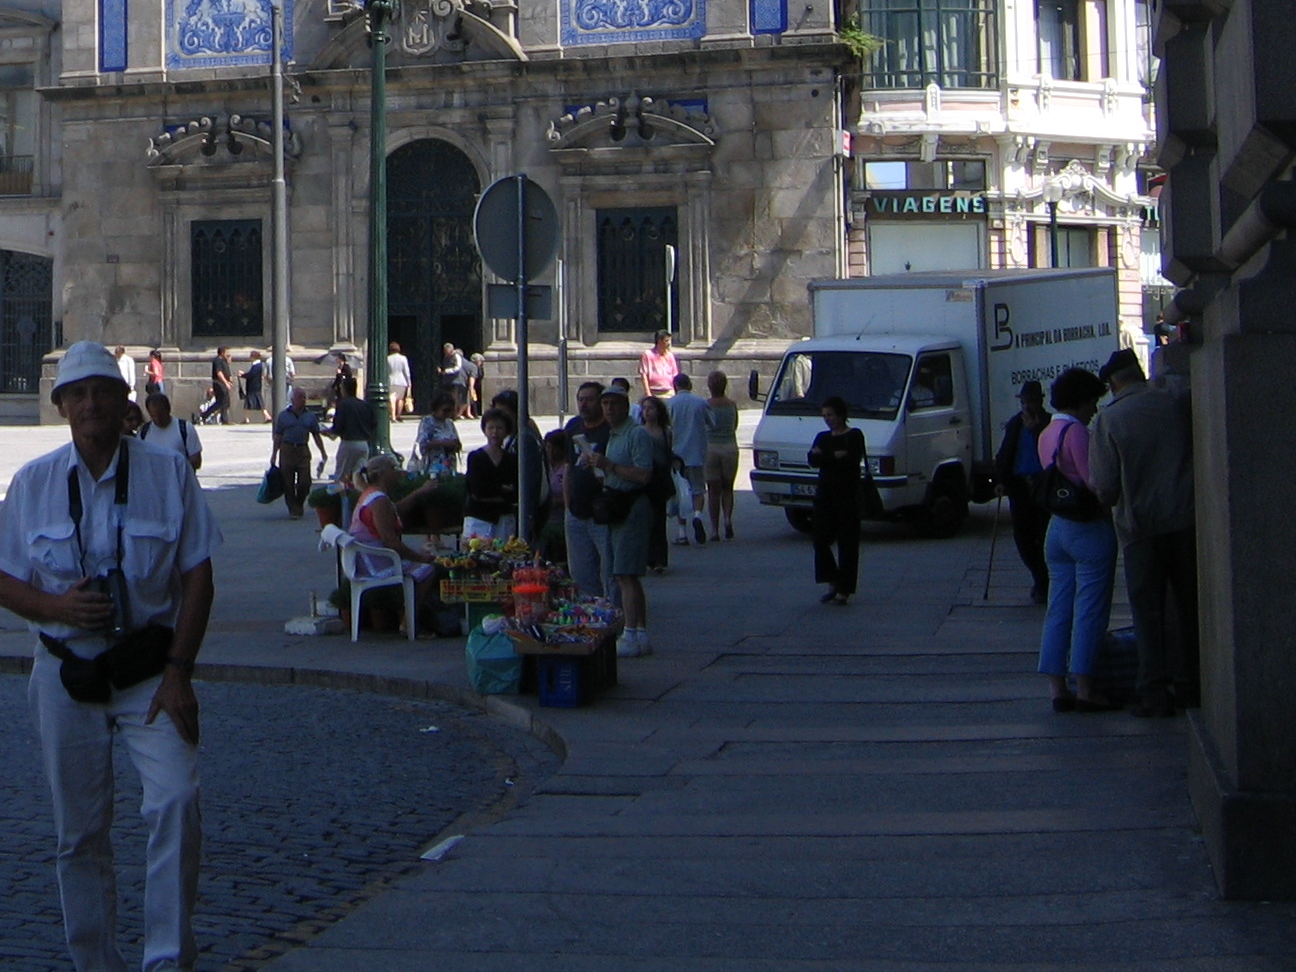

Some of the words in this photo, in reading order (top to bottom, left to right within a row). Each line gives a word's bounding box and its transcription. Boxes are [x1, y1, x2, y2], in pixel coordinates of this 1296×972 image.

[873, 196, 984, 213] VIAGENS
[1021, 330, 1053, 348] PRINCIPAL
[1011, 366, 1055, 385] BORRACHAS
